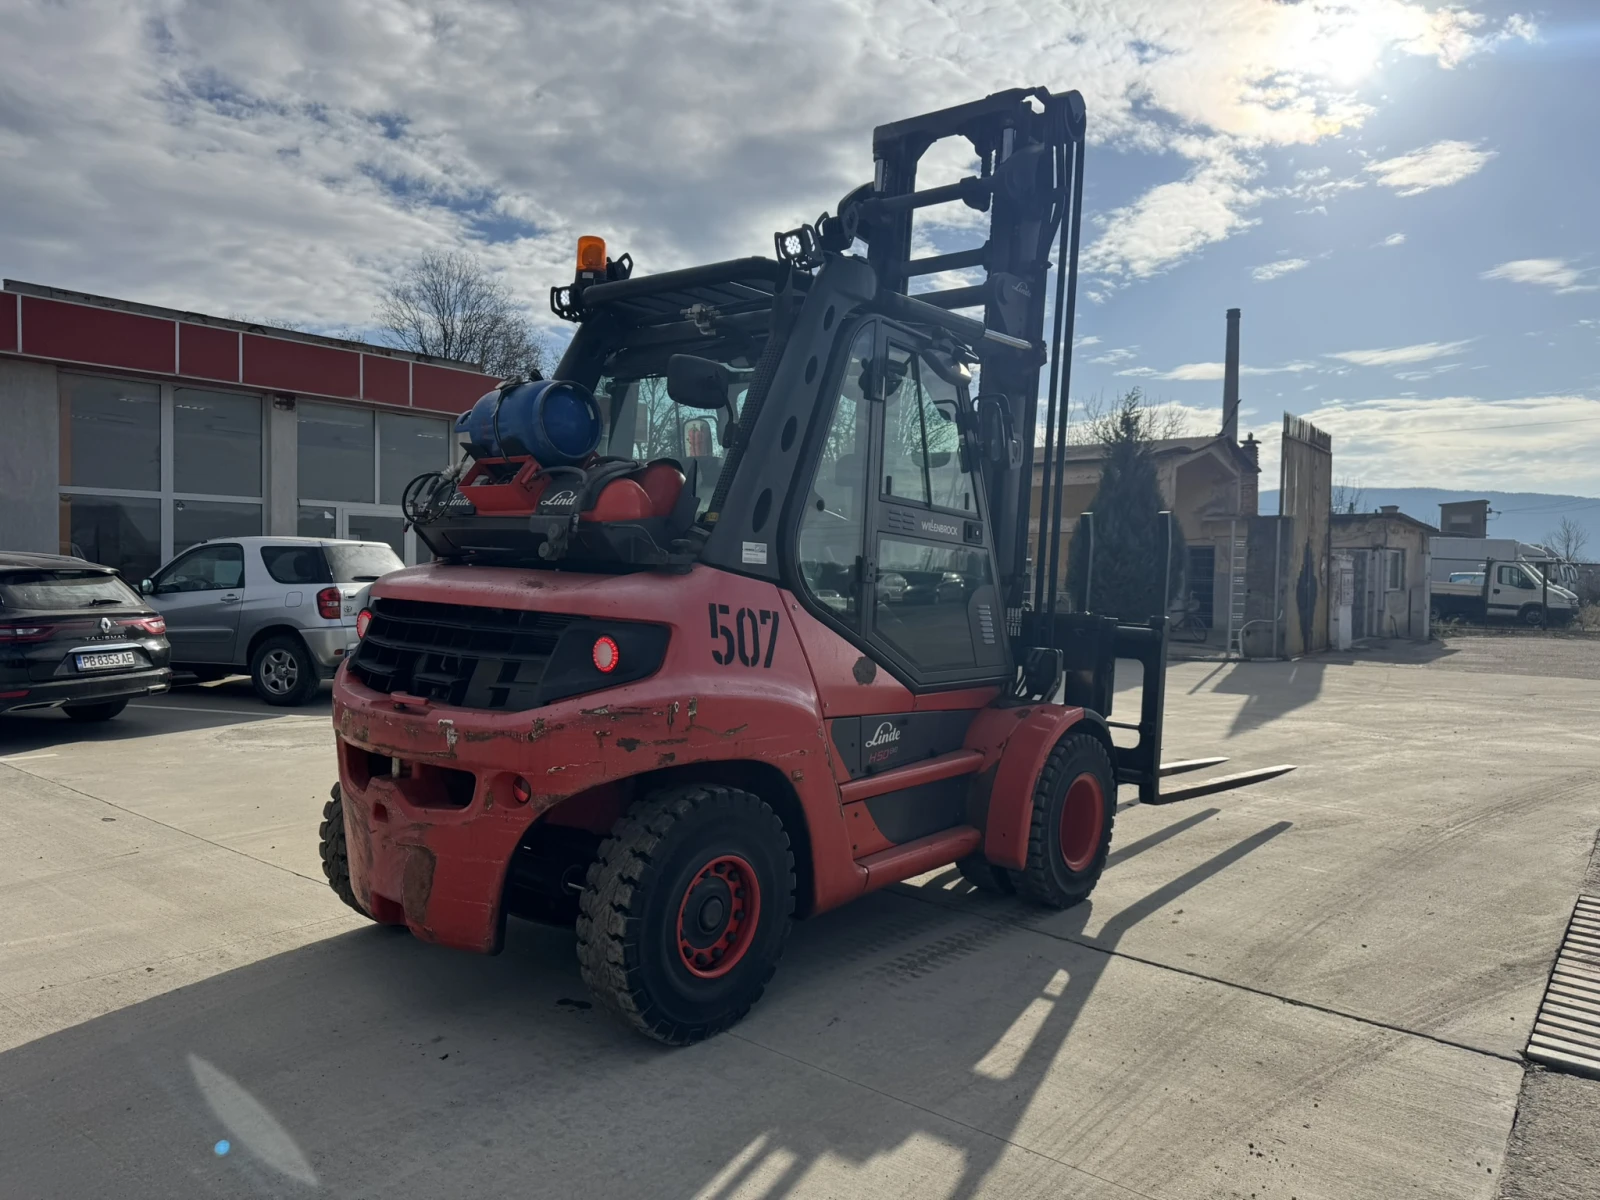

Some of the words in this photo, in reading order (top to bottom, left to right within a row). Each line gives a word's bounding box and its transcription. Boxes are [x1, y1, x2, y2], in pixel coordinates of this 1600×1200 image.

[540, 490, 577, 506] Lind
[921, 519, 958, 536] WILLENBROCK
[708, 602, 780, 669] 507
[82, 655, 97, 668] PB
[97, 653, 121, 666] 8353
[121, 652, 133, 665] AE
[865, 721, 901, 748] Linde
